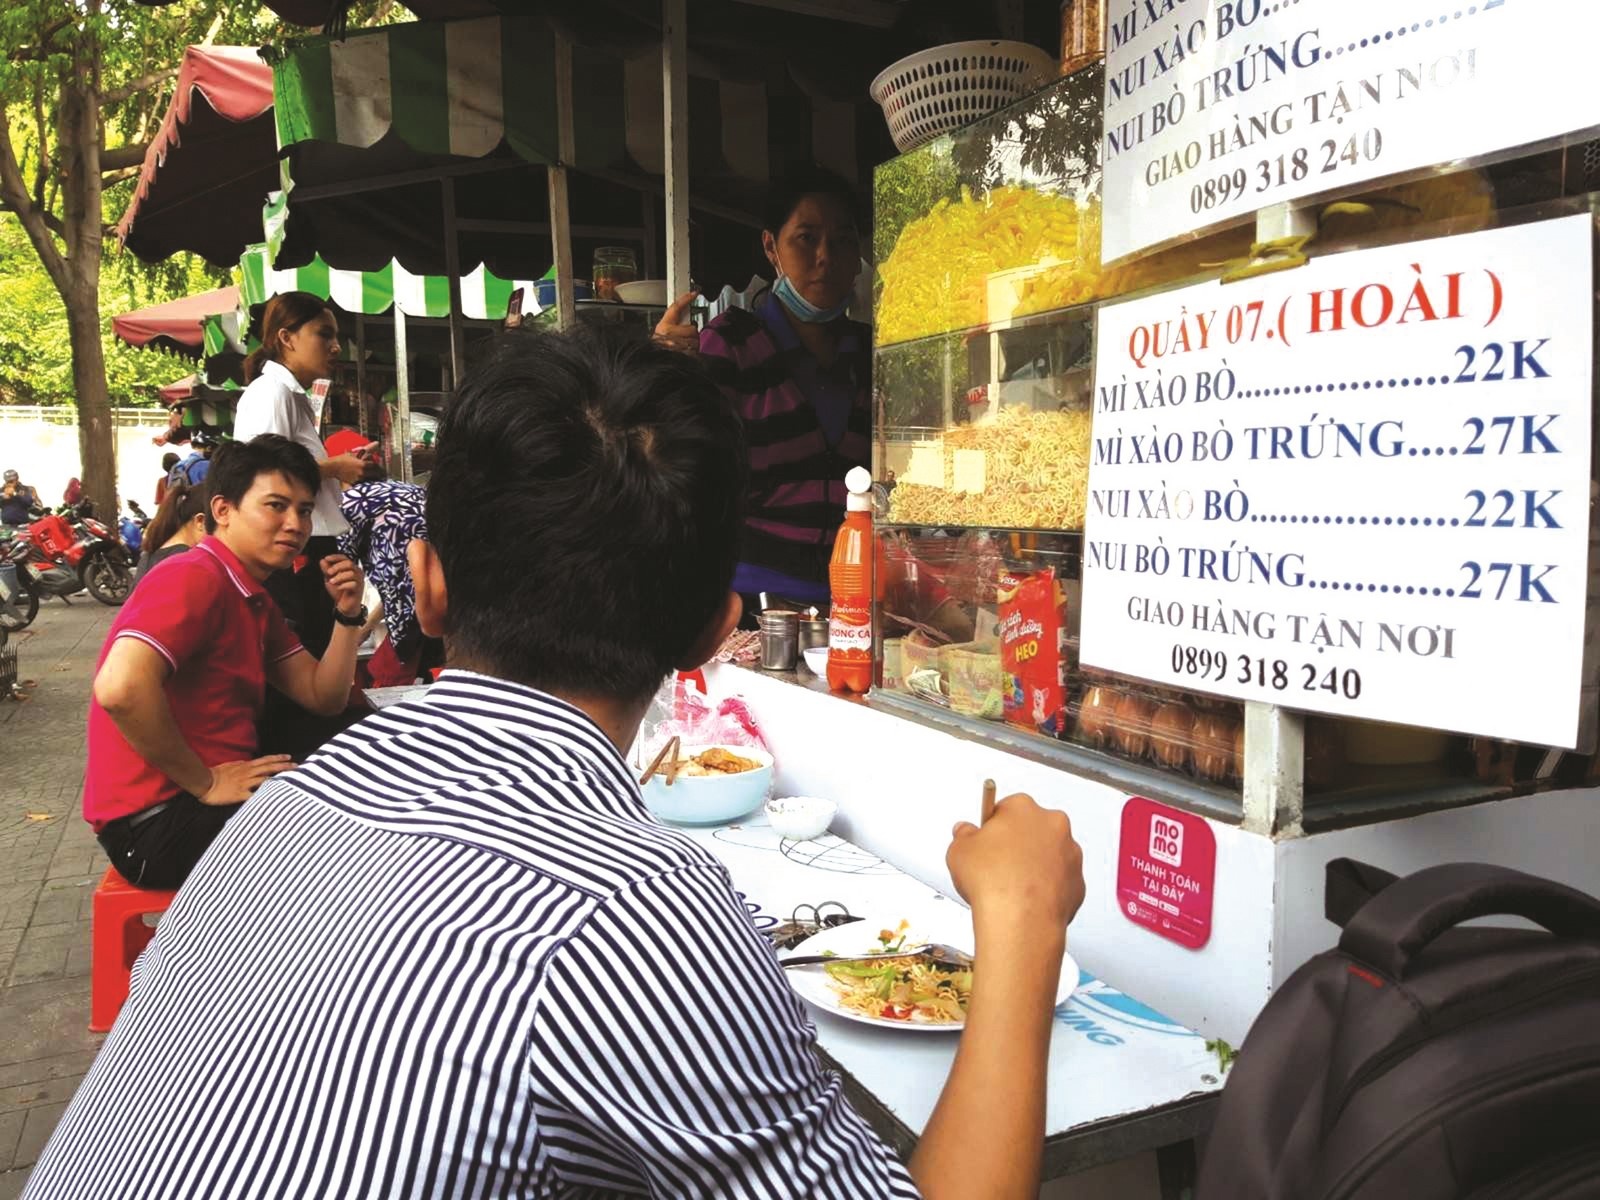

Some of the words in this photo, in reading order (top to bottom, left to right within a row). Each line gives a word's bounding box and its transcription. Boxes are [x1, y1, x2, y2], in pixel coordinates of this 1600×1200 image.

[1107, 56, 1147, 108] NUI
[1152, 19, 1207, 80] XÀO
[1105, 112, 1146, 161] NUI
[1152, 83, 1185, 137] BÒ
[1193, 28, 1322, 112] TRỨNG
[1145, 141, 1202, 187] GIAO
[1208, 114, 1294, 161] HÀNG
[1303, 80, 1384, 125] TẬN
[1190, 168, 1247, 214] 0899
[1255, 147, 1309, 193] 318
[1319, 127, 1383, 174] 240
[1128, 305, 1217, 369] QUẦY
[1306, 263, 1466, 335] HOÀI
[1098, 374, 1127, 414] MÌ
[1132, 369, 1187, 412] XÀO
[1094, 431, 1123, 467] MÌ
[1128, 424, 1183, 465] XÀO
[1191, 420, 1234, 462] BÒ
[1091, 489, 1130, 519] NUI
[1136, 481, 1195, 520] XÀO
[1087, 540, 1127, 572] NUI
[1135, 536, 1170, 576] BÒ
[1015, 640, 1038, 663] HEO
[1127, 595, 1185, 627] GIAO
[1191, 599, 1277, 642] HÀNG
[1286, 613, 1364, 654] TẬN
[1376, 622, 1457, 659] NƠI
[1171, 643, 1227, 682] 0899
[1236, 654, 1289, 691] 318
[1301, 664, 1362, 699] 240
[1130, 855, 1167, 880] THANH
[1169, 871, 1200, 894] TOÁN
[1142, 875, 1160, 893] TẠI
[1161, 884, 1185, 903] ĐÂY
